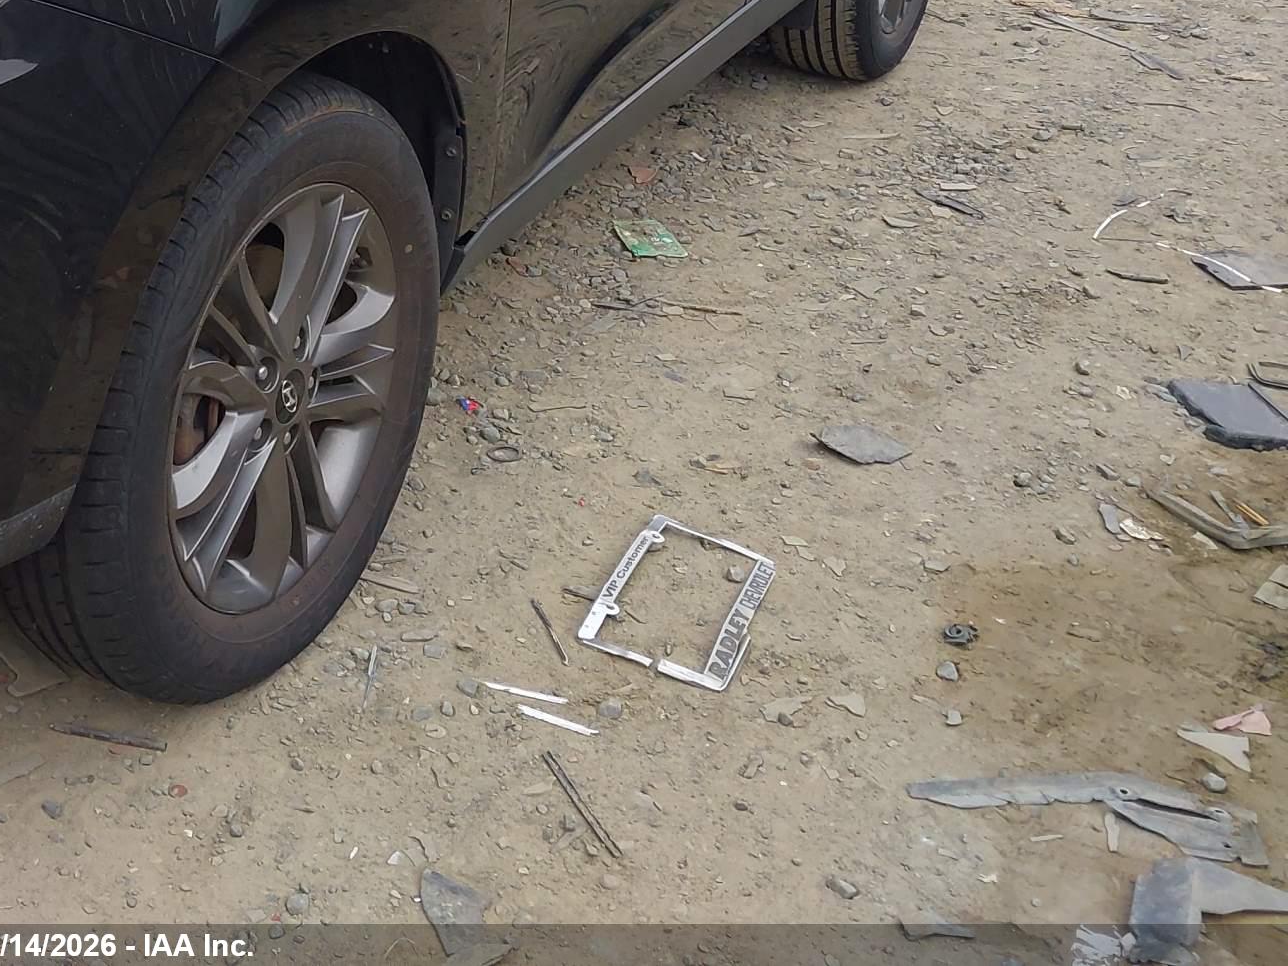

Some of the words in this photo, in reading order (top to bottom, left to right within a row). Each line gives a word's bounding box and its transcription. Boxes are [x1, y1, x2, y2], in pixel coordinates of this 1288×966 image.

[602, 579, 620, 599] VIP
[616, 536, 649, 579] Customer
[708, 607, 750, 680] RADLEY
